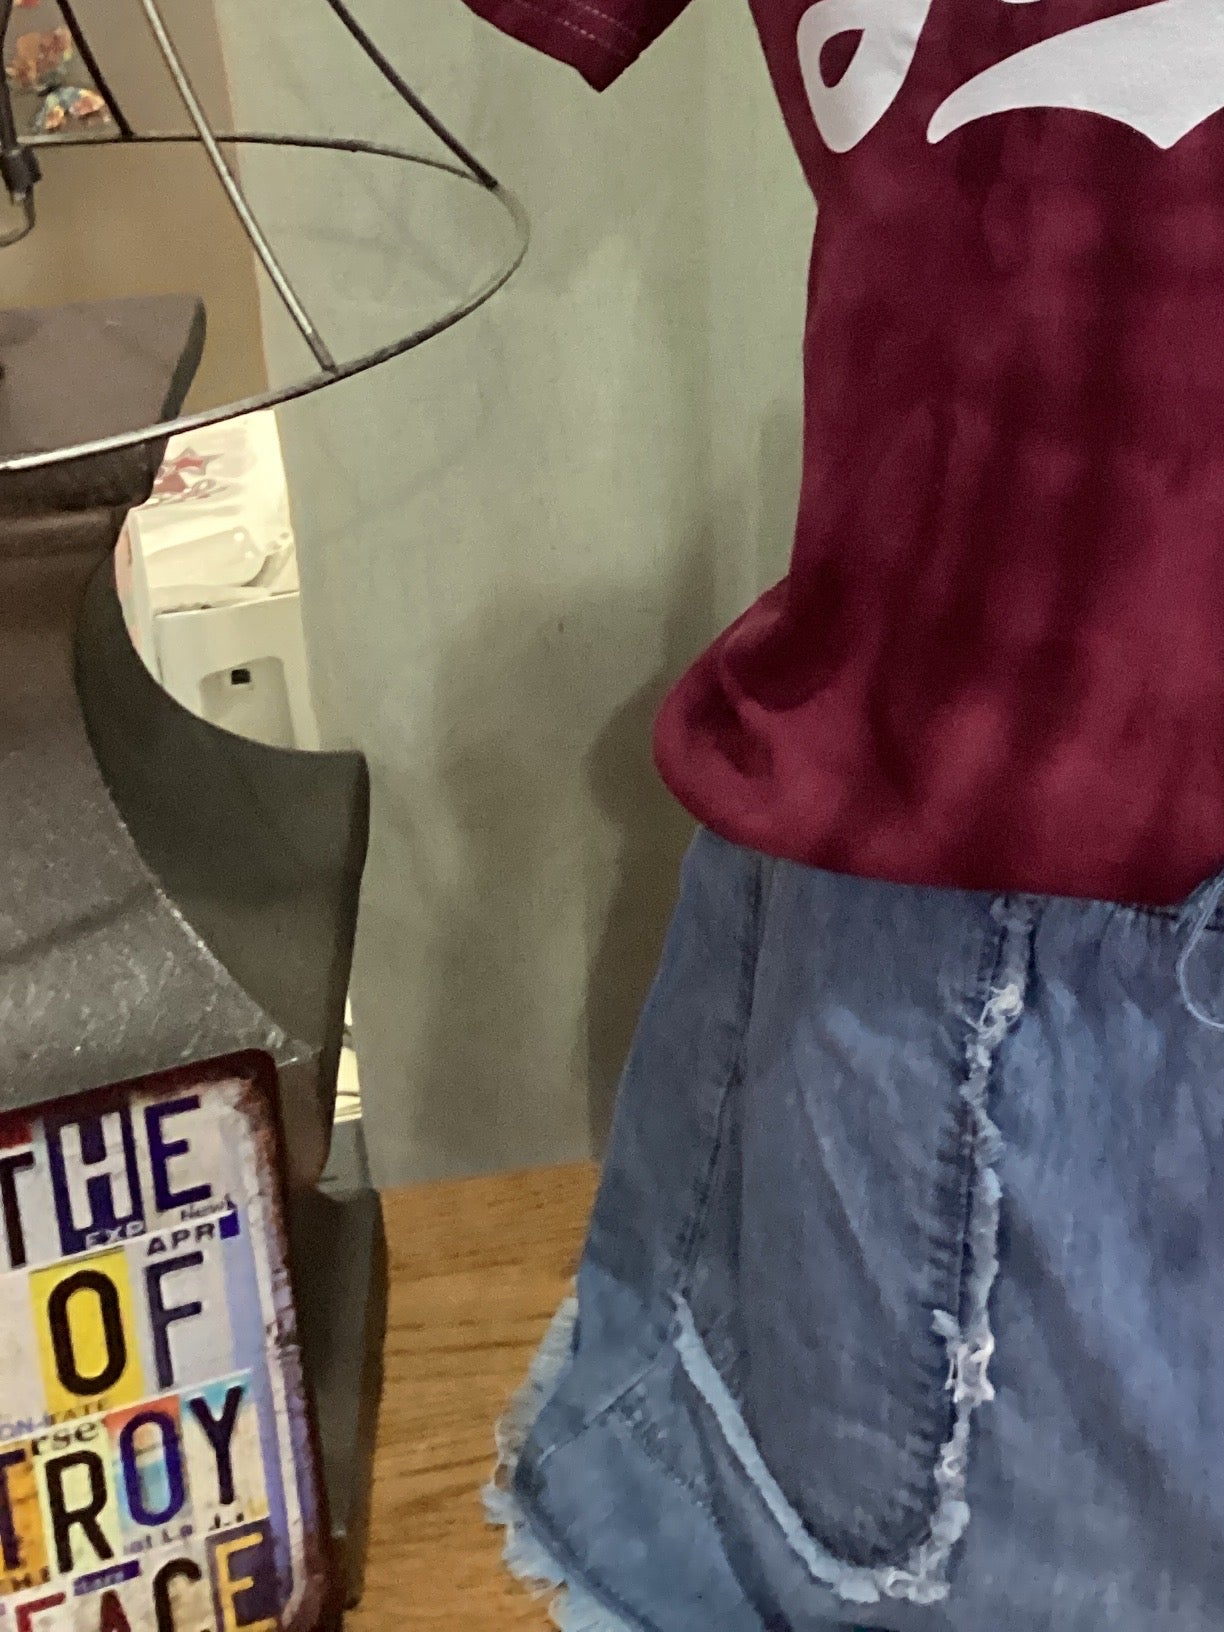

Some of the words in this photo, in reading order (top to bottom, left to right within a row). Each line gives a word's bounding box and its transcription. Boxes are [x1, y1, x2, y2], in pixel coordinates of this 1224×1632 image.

[0, 1096, 212, 1267] THE
[147, 1223, 216, 1256] APR
[46, 1251, 205, 1397] OF
[0, 1385, 245, 1574] TROY
